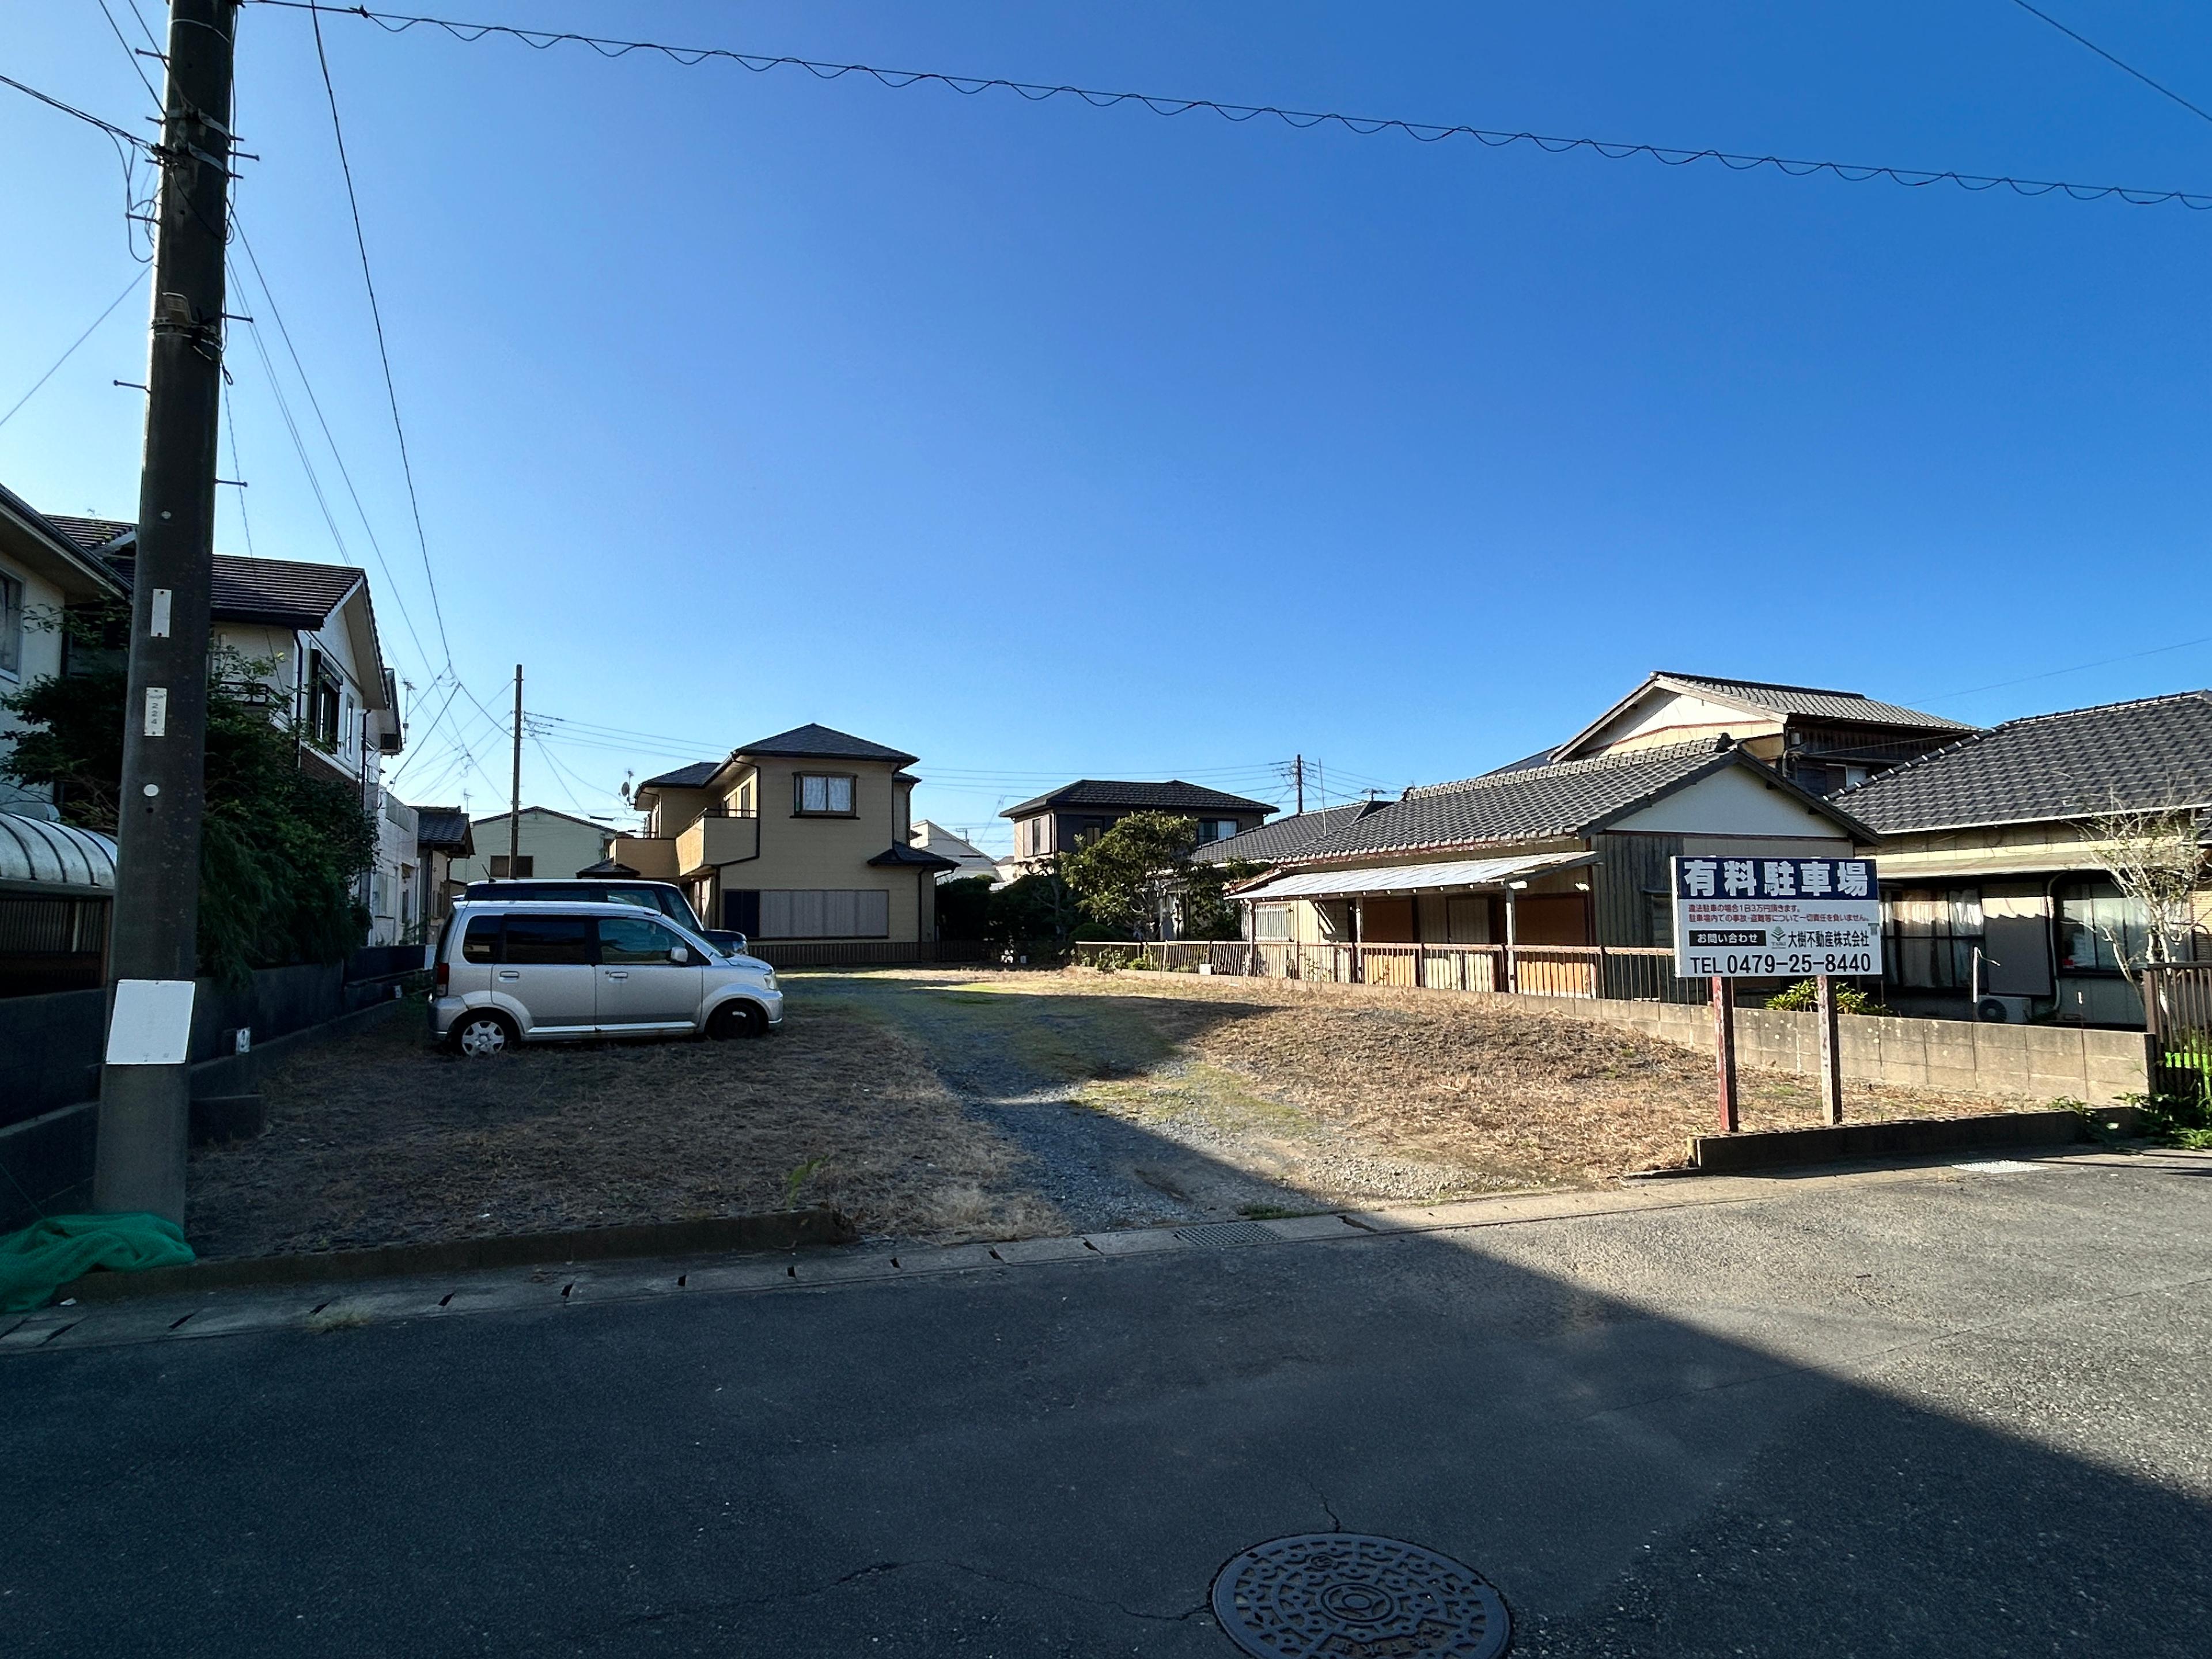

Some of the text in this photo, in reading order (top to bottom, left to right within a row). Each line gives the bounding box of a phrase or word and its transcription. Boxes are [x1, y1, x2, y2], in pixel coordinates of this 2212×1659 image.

[1684, 859, 1868, 896] 有料駐車場
[1697, 933, 1758, 944] お問い合わせ
[1788, 930, 1870, 948] 大樹不動産株式会社
[1691, 953, 1871, 974] TEL 0479-25-8440
